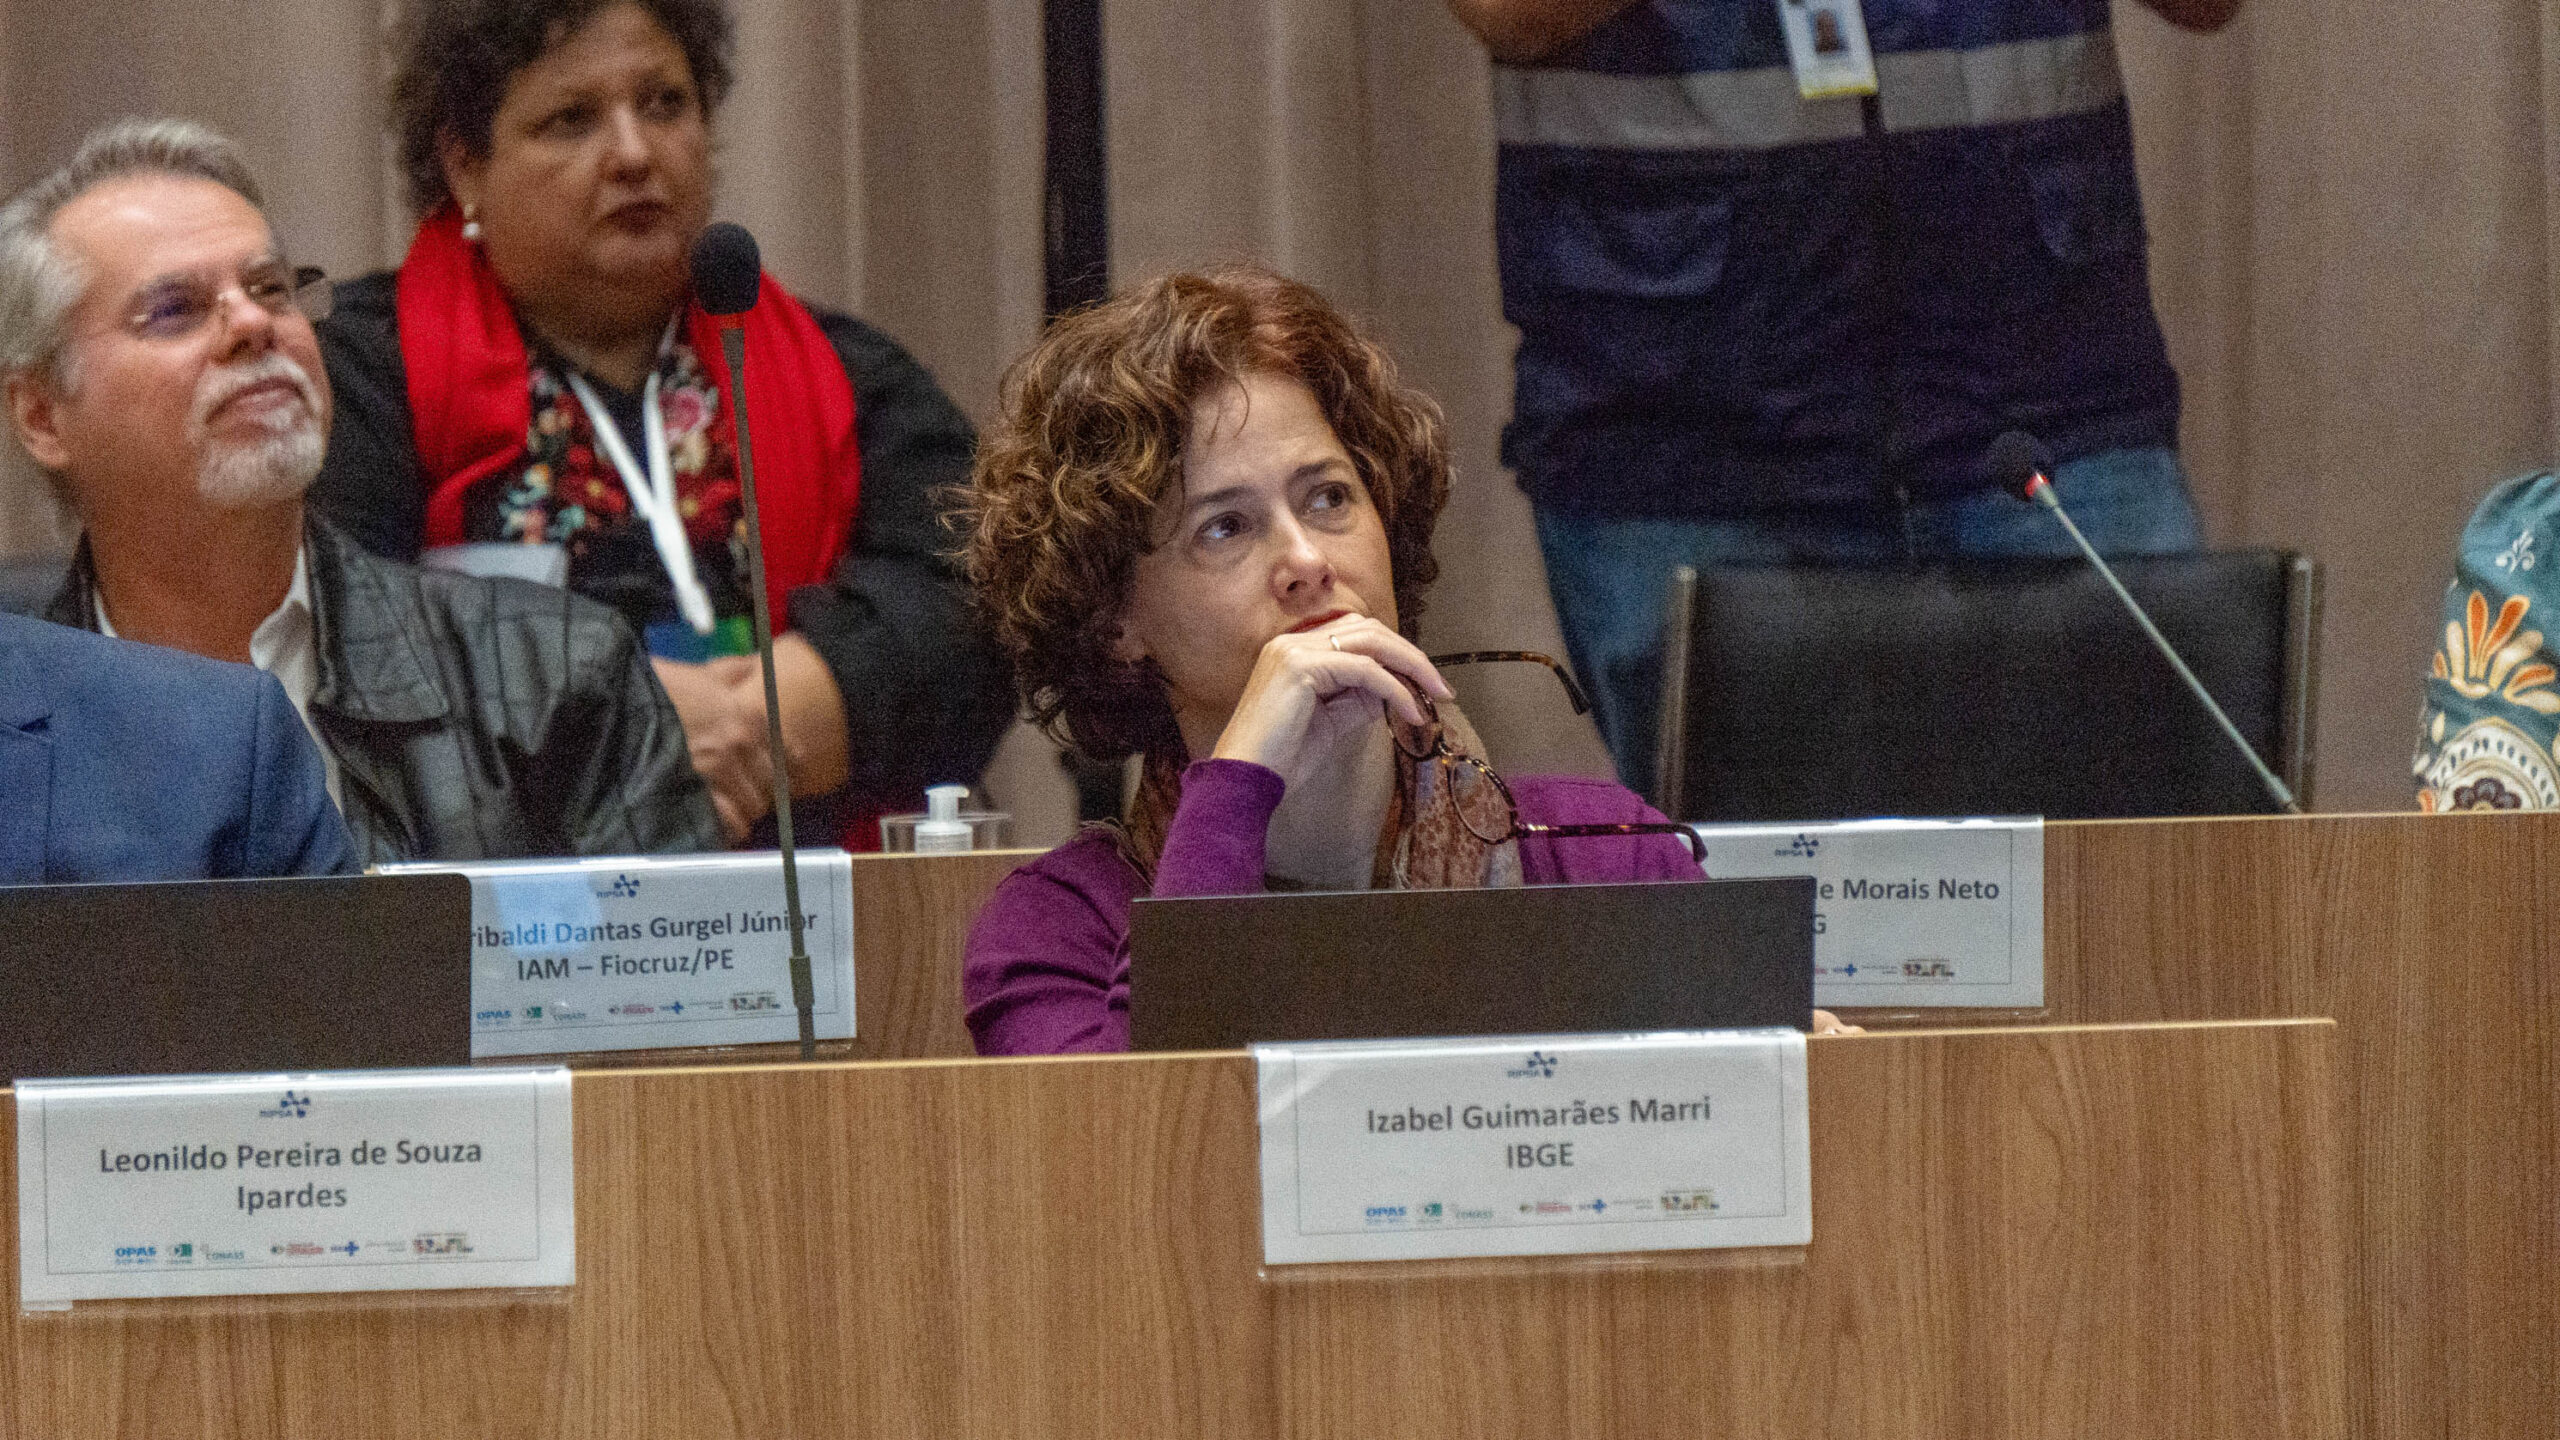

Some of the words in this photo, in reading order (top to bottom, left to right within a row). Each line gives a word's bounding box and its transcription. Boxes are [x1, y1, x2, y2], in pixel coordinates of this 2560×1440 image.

[1819, 883, 1834, 900] e
[1843, 879, 1930, 900] Morais
[1938, 878, 2000, 900] Neto
[471, 922, 546, 948] ibaldi
[555, 920, 642, 945] Dantas
[650, 914, 732, 946] Gurgel
[518, 958, 570, 981] IAM
[601, 949, 734, 977] Fiocruz/PE
[1367, 1105, 1453, 1134] Izabel
[1462, 1100, 1620, 1131] Guimarães
[1630, 1096, 1712, 1123] Marri
[100, 1144, 228, 1174] Leonildo
[237, 1140, 341, 1169] Pereira
[351, 1139, 387, 1166] de
[396, 1138, 483, 1165] Souza
[1506, 1144, 1574, 1170] IBGE
[237, 1182, 348, 1214] Ipardes
